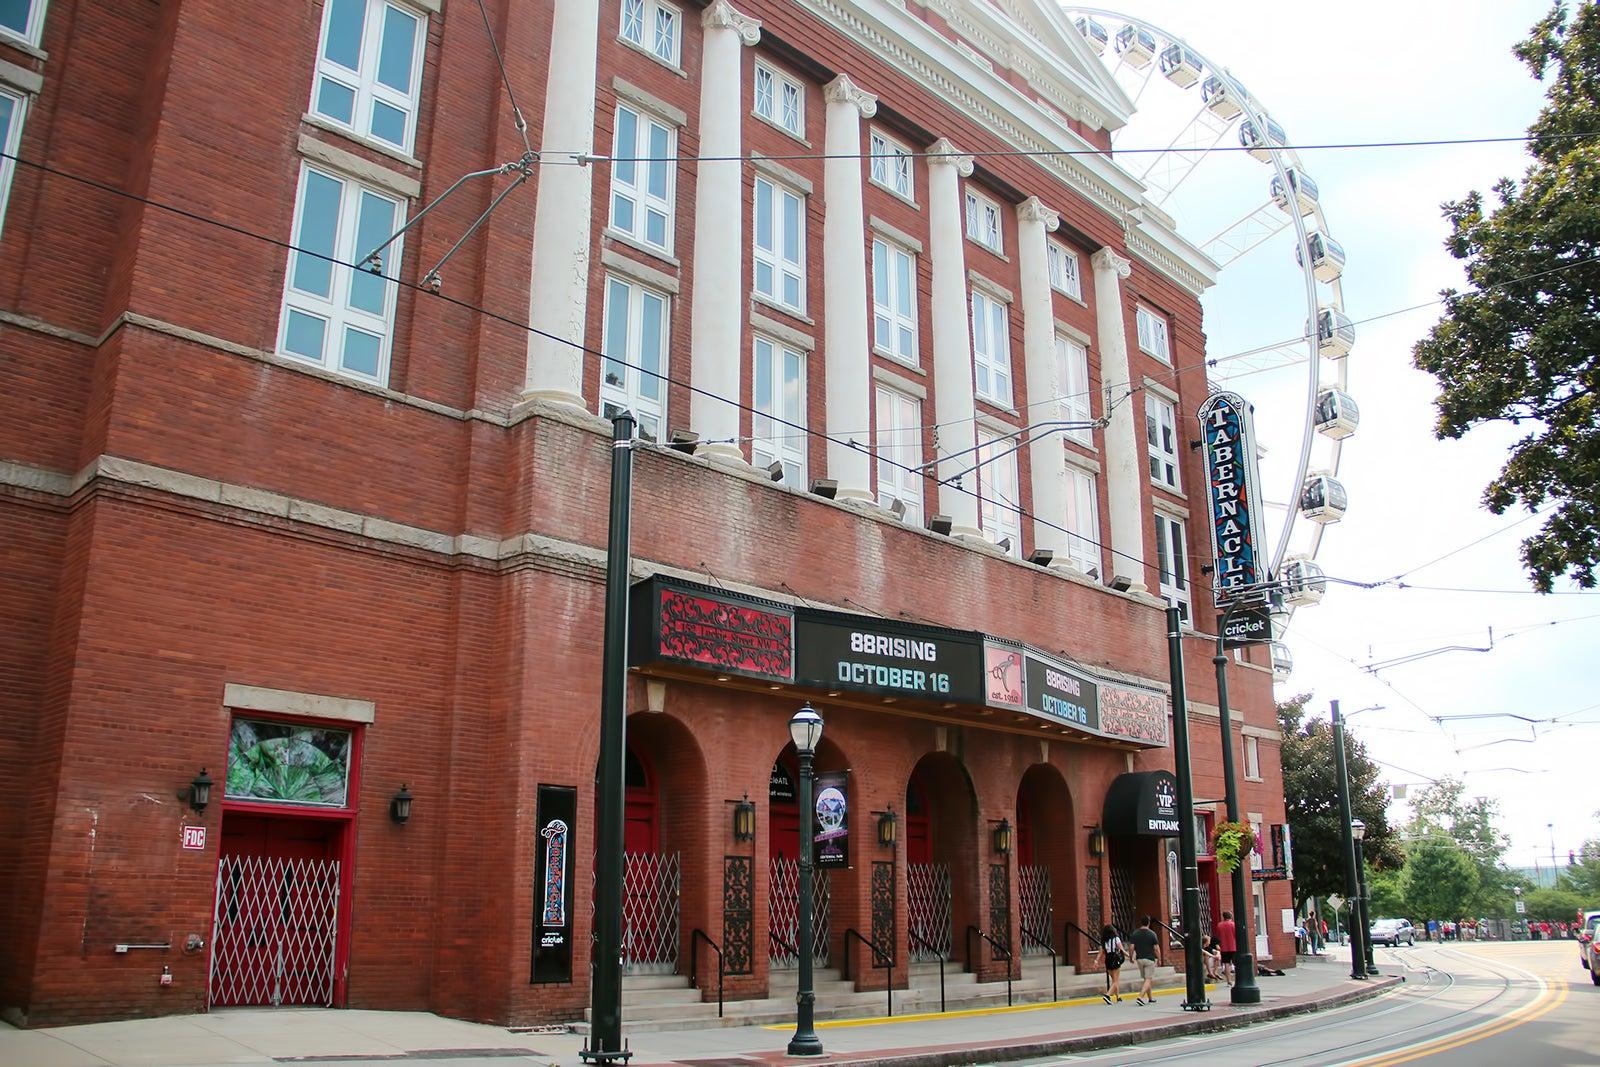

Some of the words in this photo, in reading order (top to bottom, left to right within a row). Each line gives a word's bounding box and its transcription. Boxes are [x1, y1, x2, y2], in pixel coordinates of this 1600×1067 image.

[1209, 407, 1244, 589] TABERNACLE
[1225, 620, 1264, 635] cricket
[850, 632, 937, 662] 88RISING
[838, 661, 926, 691] OCTOBER
[930, 672, 950, 693] 16
[1046, 669, 1080, 697] 88RISING
[1042, 694, 1078, 722] OCTOBER
[1077, 705, 1087, 724] 16
[1159, 794, 1173, 807] VIP
[185, 829, 204, 847] FDC
[1148, 819, 1180, 831] ENTRANC
